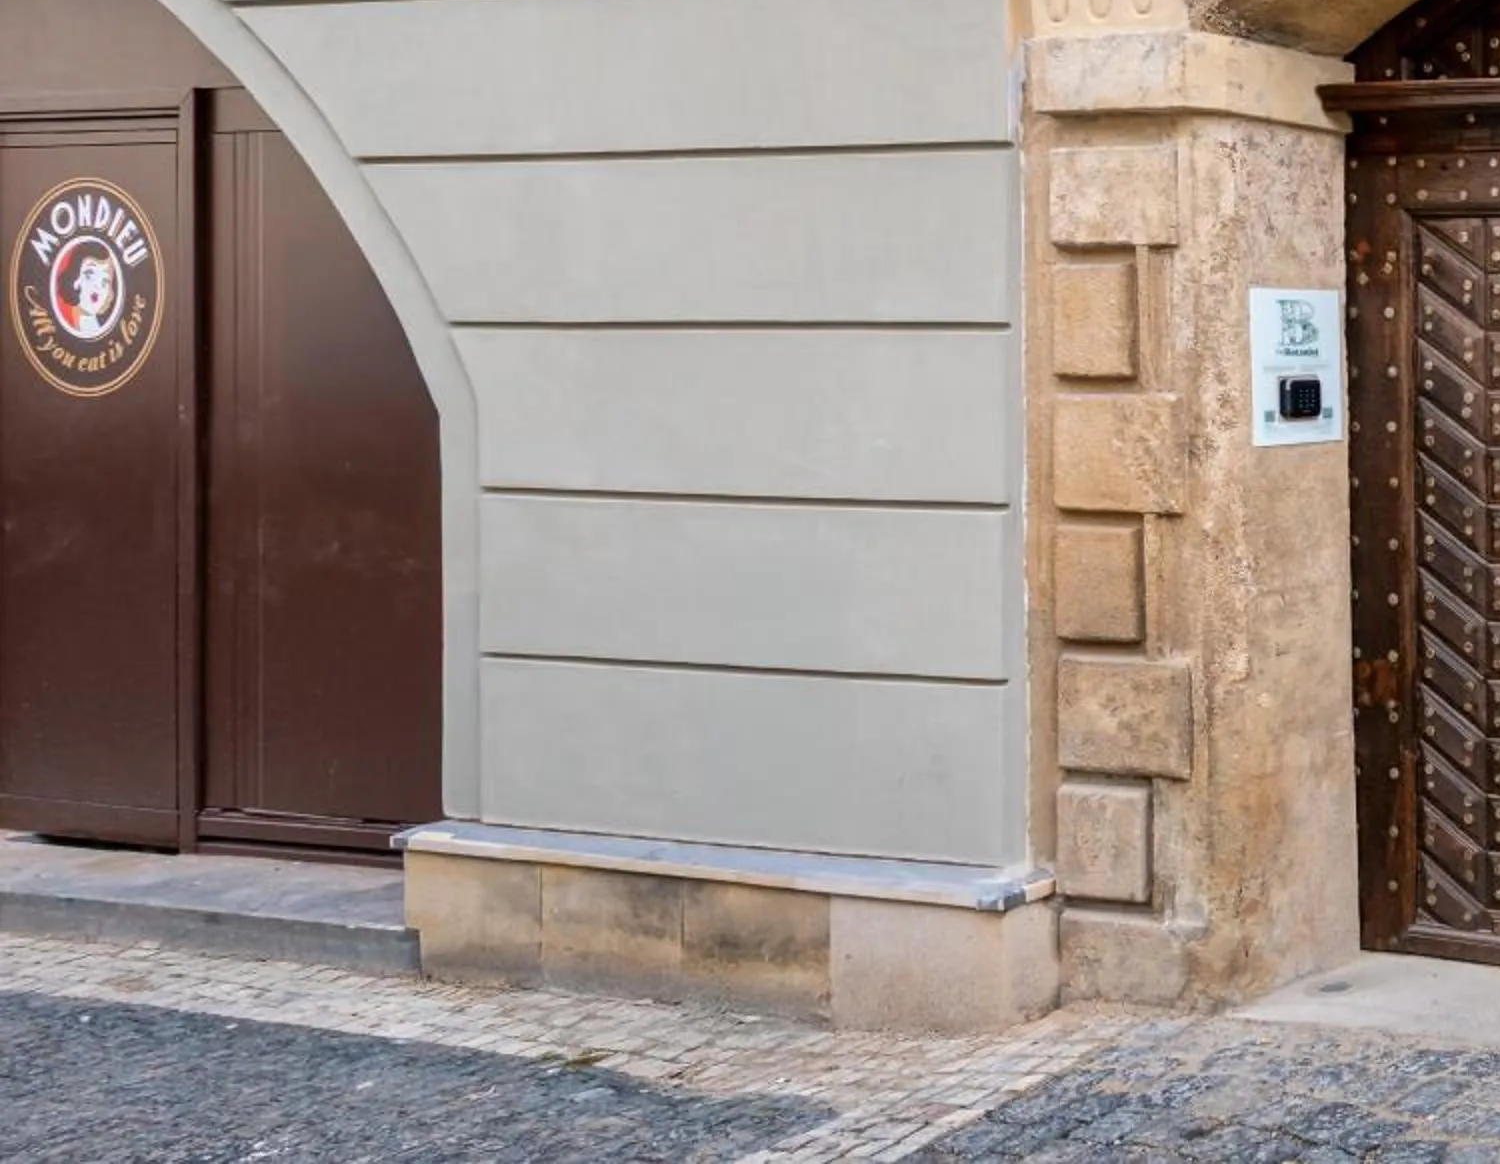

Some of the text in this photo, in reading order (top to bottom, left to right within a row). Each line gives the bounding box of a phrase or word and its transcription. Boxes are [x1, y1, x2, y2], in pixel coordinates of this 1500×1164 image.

[30, 193, 148, 267] MONDIEU
[36, 336, 76, 368] you
[78, 352, 106, 372] eat
[108, 339, 124, 362] is
[120, 294, 147, 345] love
